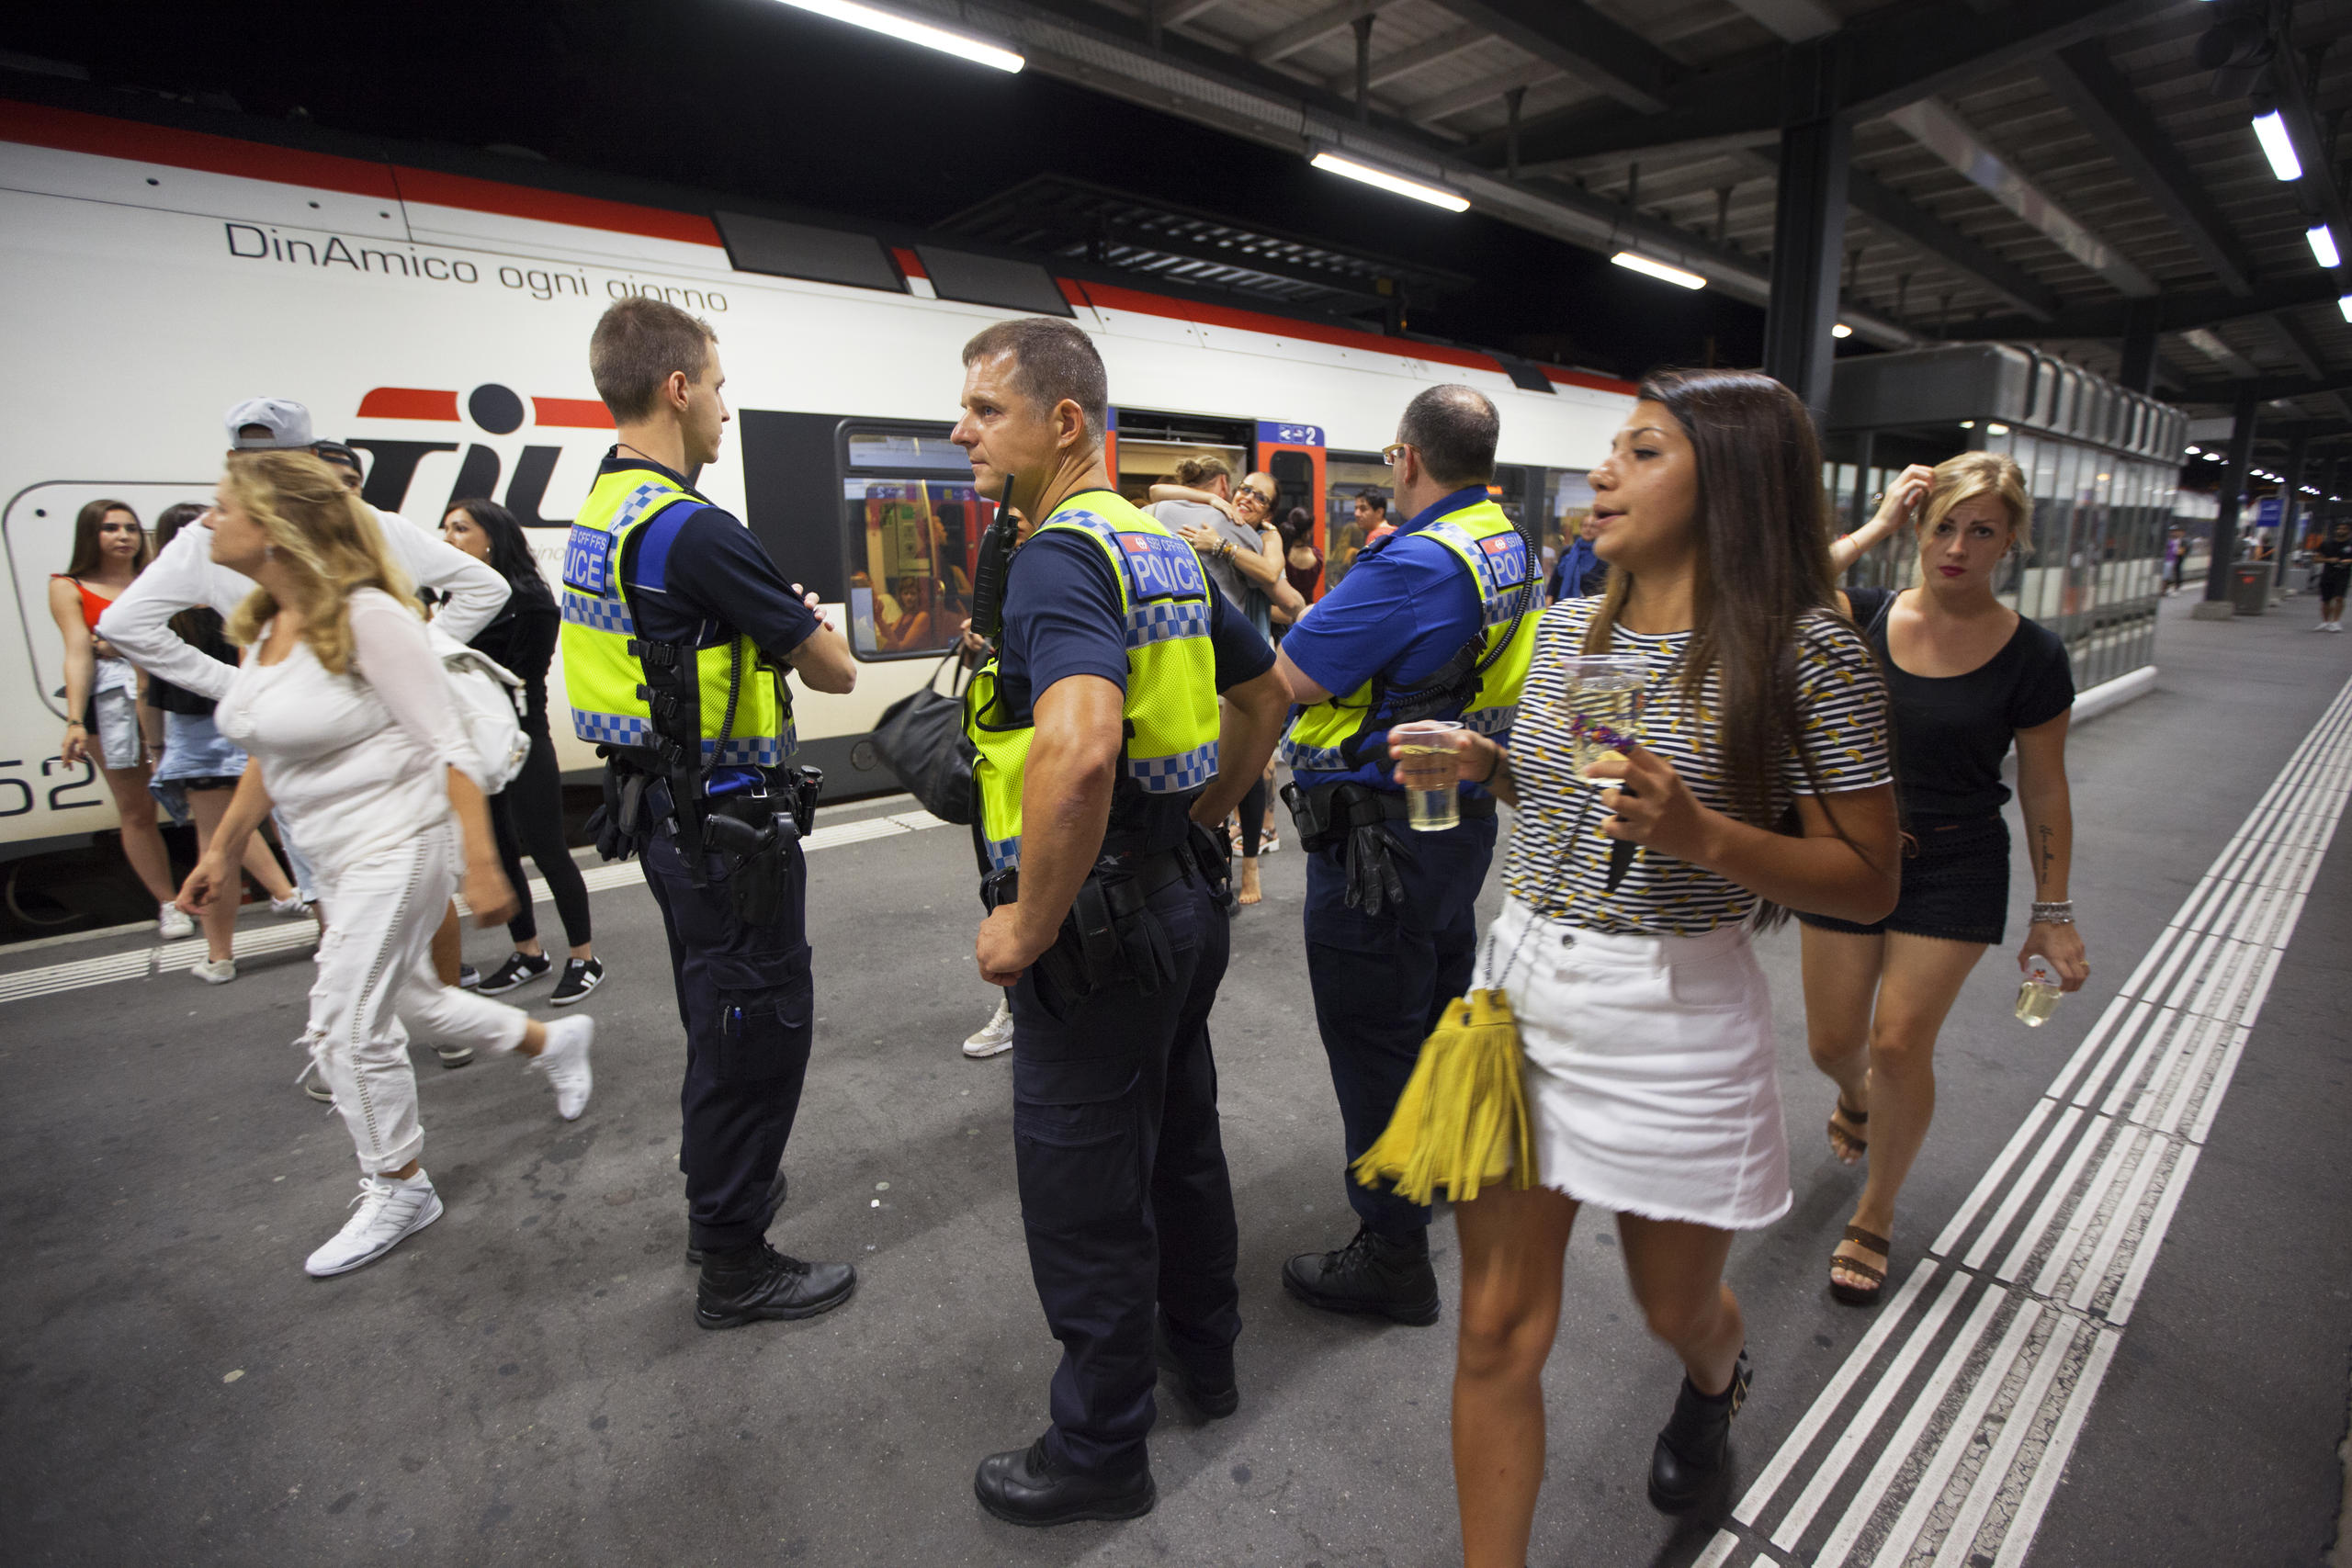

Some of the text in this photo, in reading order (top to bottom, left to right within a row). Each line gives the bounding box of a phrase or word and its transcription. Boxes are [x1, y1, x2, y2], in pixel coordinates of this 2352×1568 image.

[225, 222, 479, 284] DinAmico
[499, 265, 589, 301] ogni
[1306, 426, 1317, 446] 2
[590, 535, 607, 552] FFS
[1130, 553, 1204, 592] POICE
